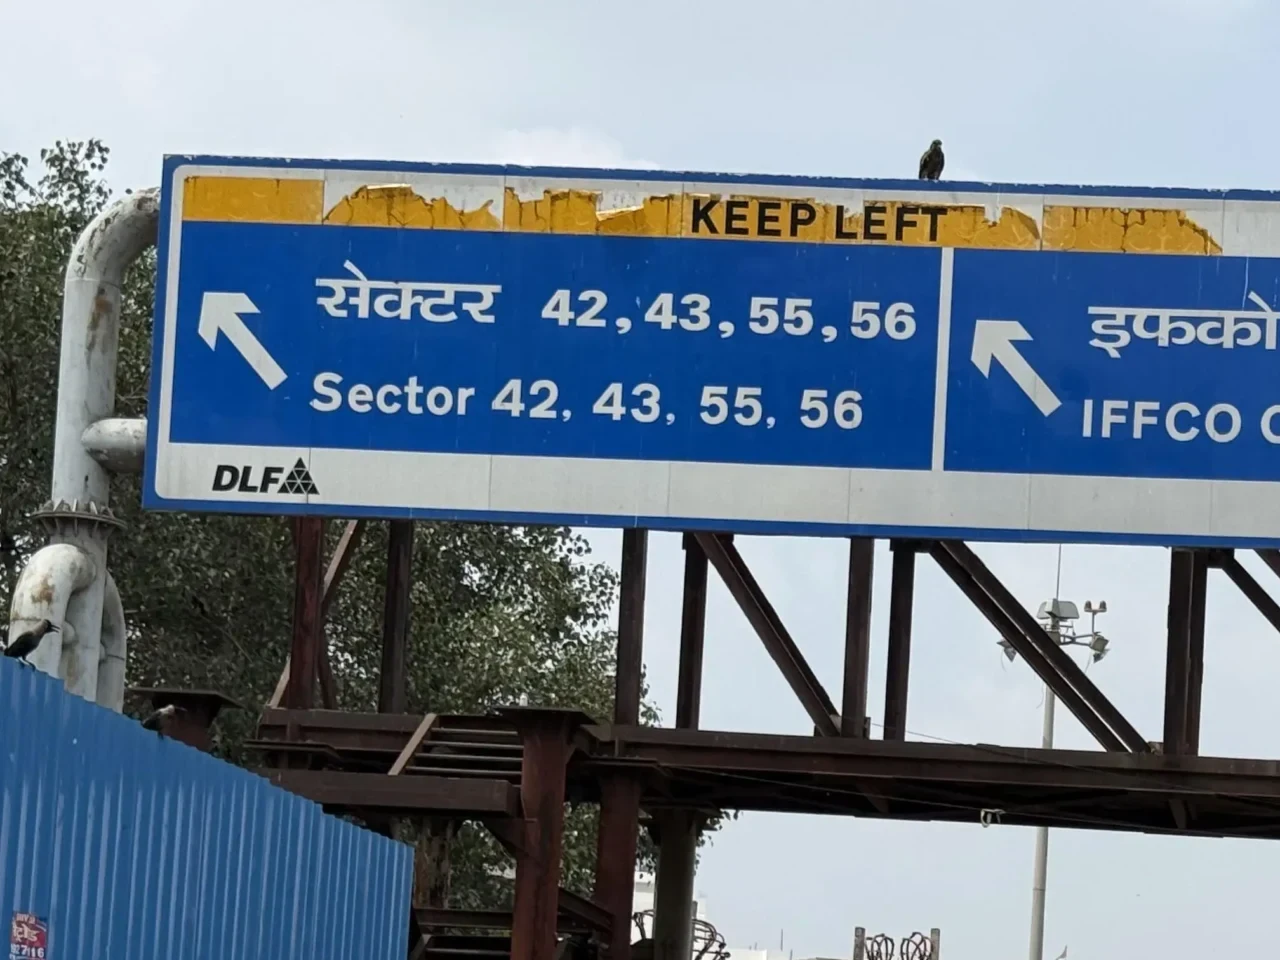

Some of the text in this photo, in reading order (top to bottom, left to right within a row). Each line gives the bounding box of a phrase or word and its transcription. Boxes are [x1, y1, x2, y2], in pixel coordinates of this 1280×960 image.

[692, 198, 947, 242] KEEP LEFT
[315, 259, 502, 324] सेक्टर
[310, 371, 475, 416] Sector
[800, 390, 863, 430] 56
[1081, 398, 1242, 444] IFFCO
[212, 464, 285, 495] DLF
